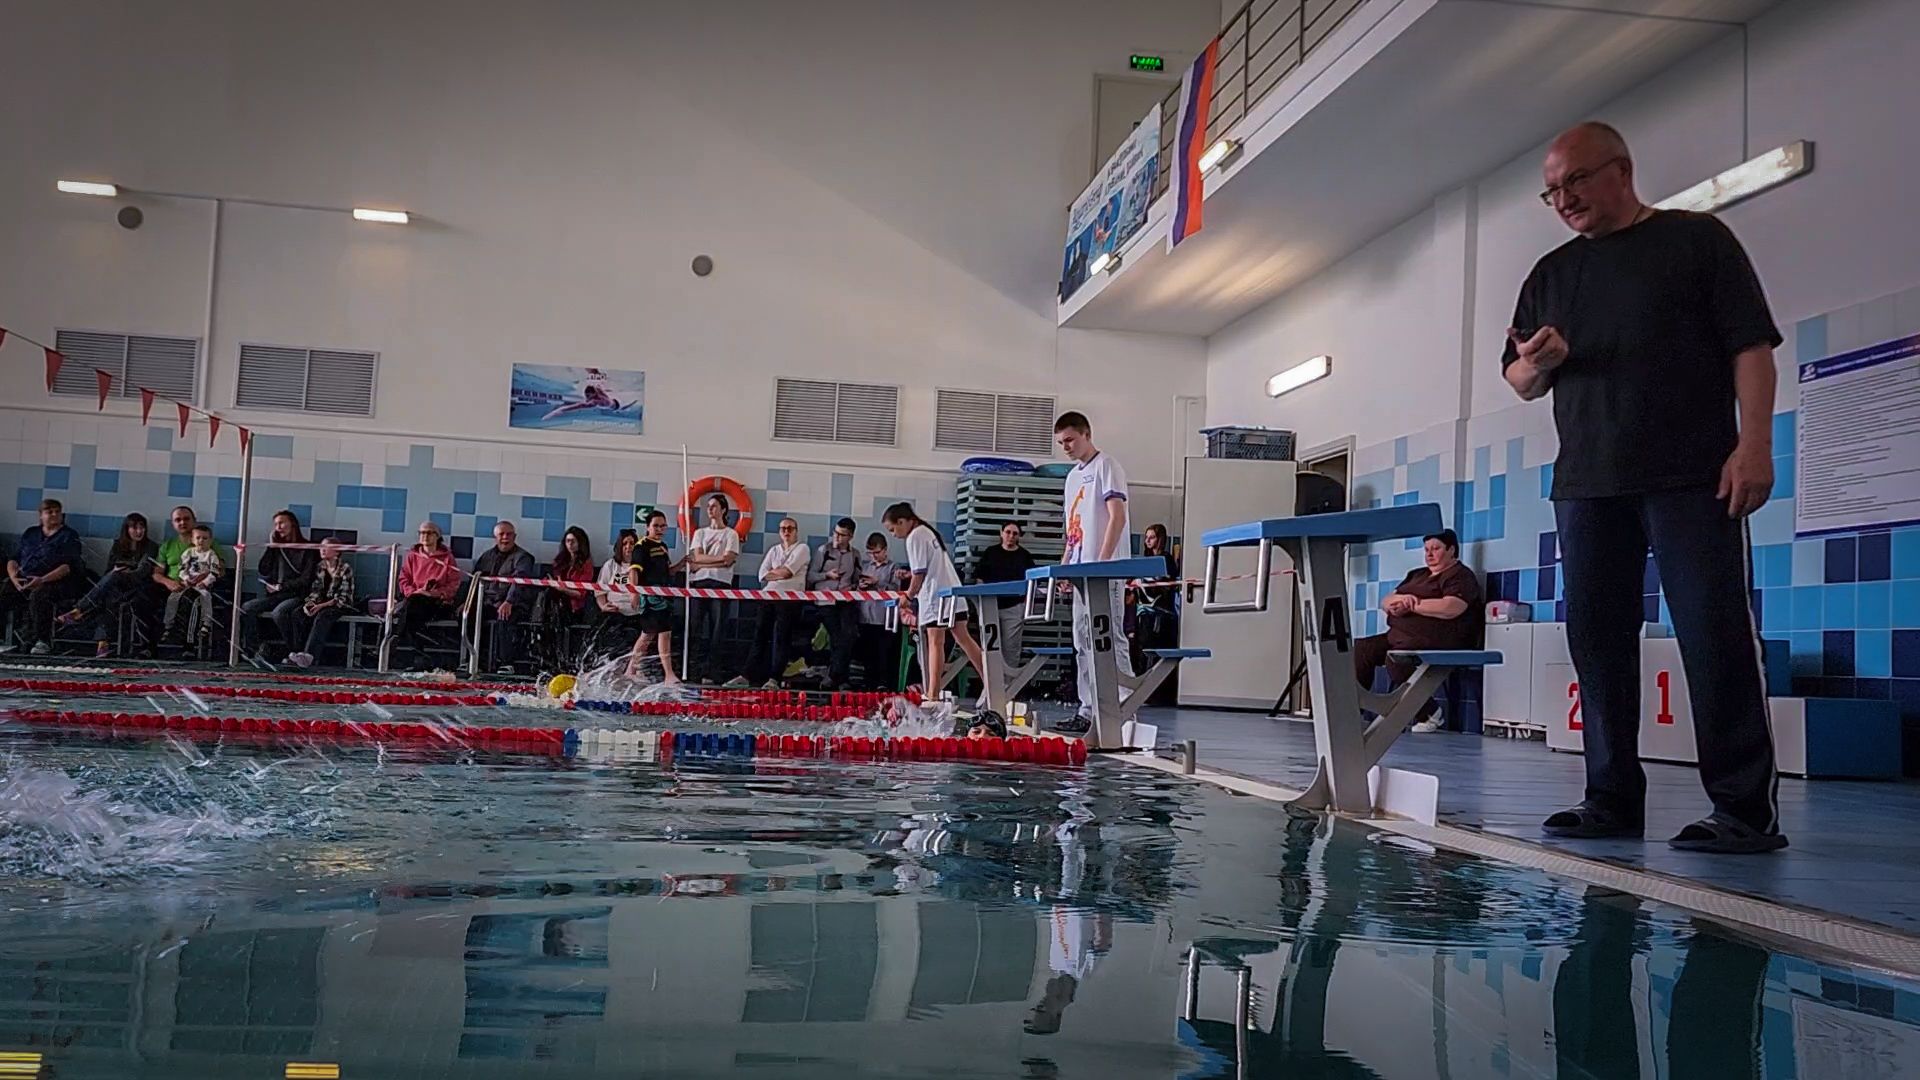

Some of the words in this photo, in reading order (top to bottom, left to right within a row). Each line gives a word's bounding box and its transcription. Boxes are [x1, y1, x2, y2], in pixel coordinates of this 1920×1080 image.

[984, 623, 1000, 652] 2
[1093, 614, 1112, 653] 3
[1320, 596, 1350, 653] 4
[1567, 681, 1585, 731] 2
[1655, 670, 1675, 725] 1
